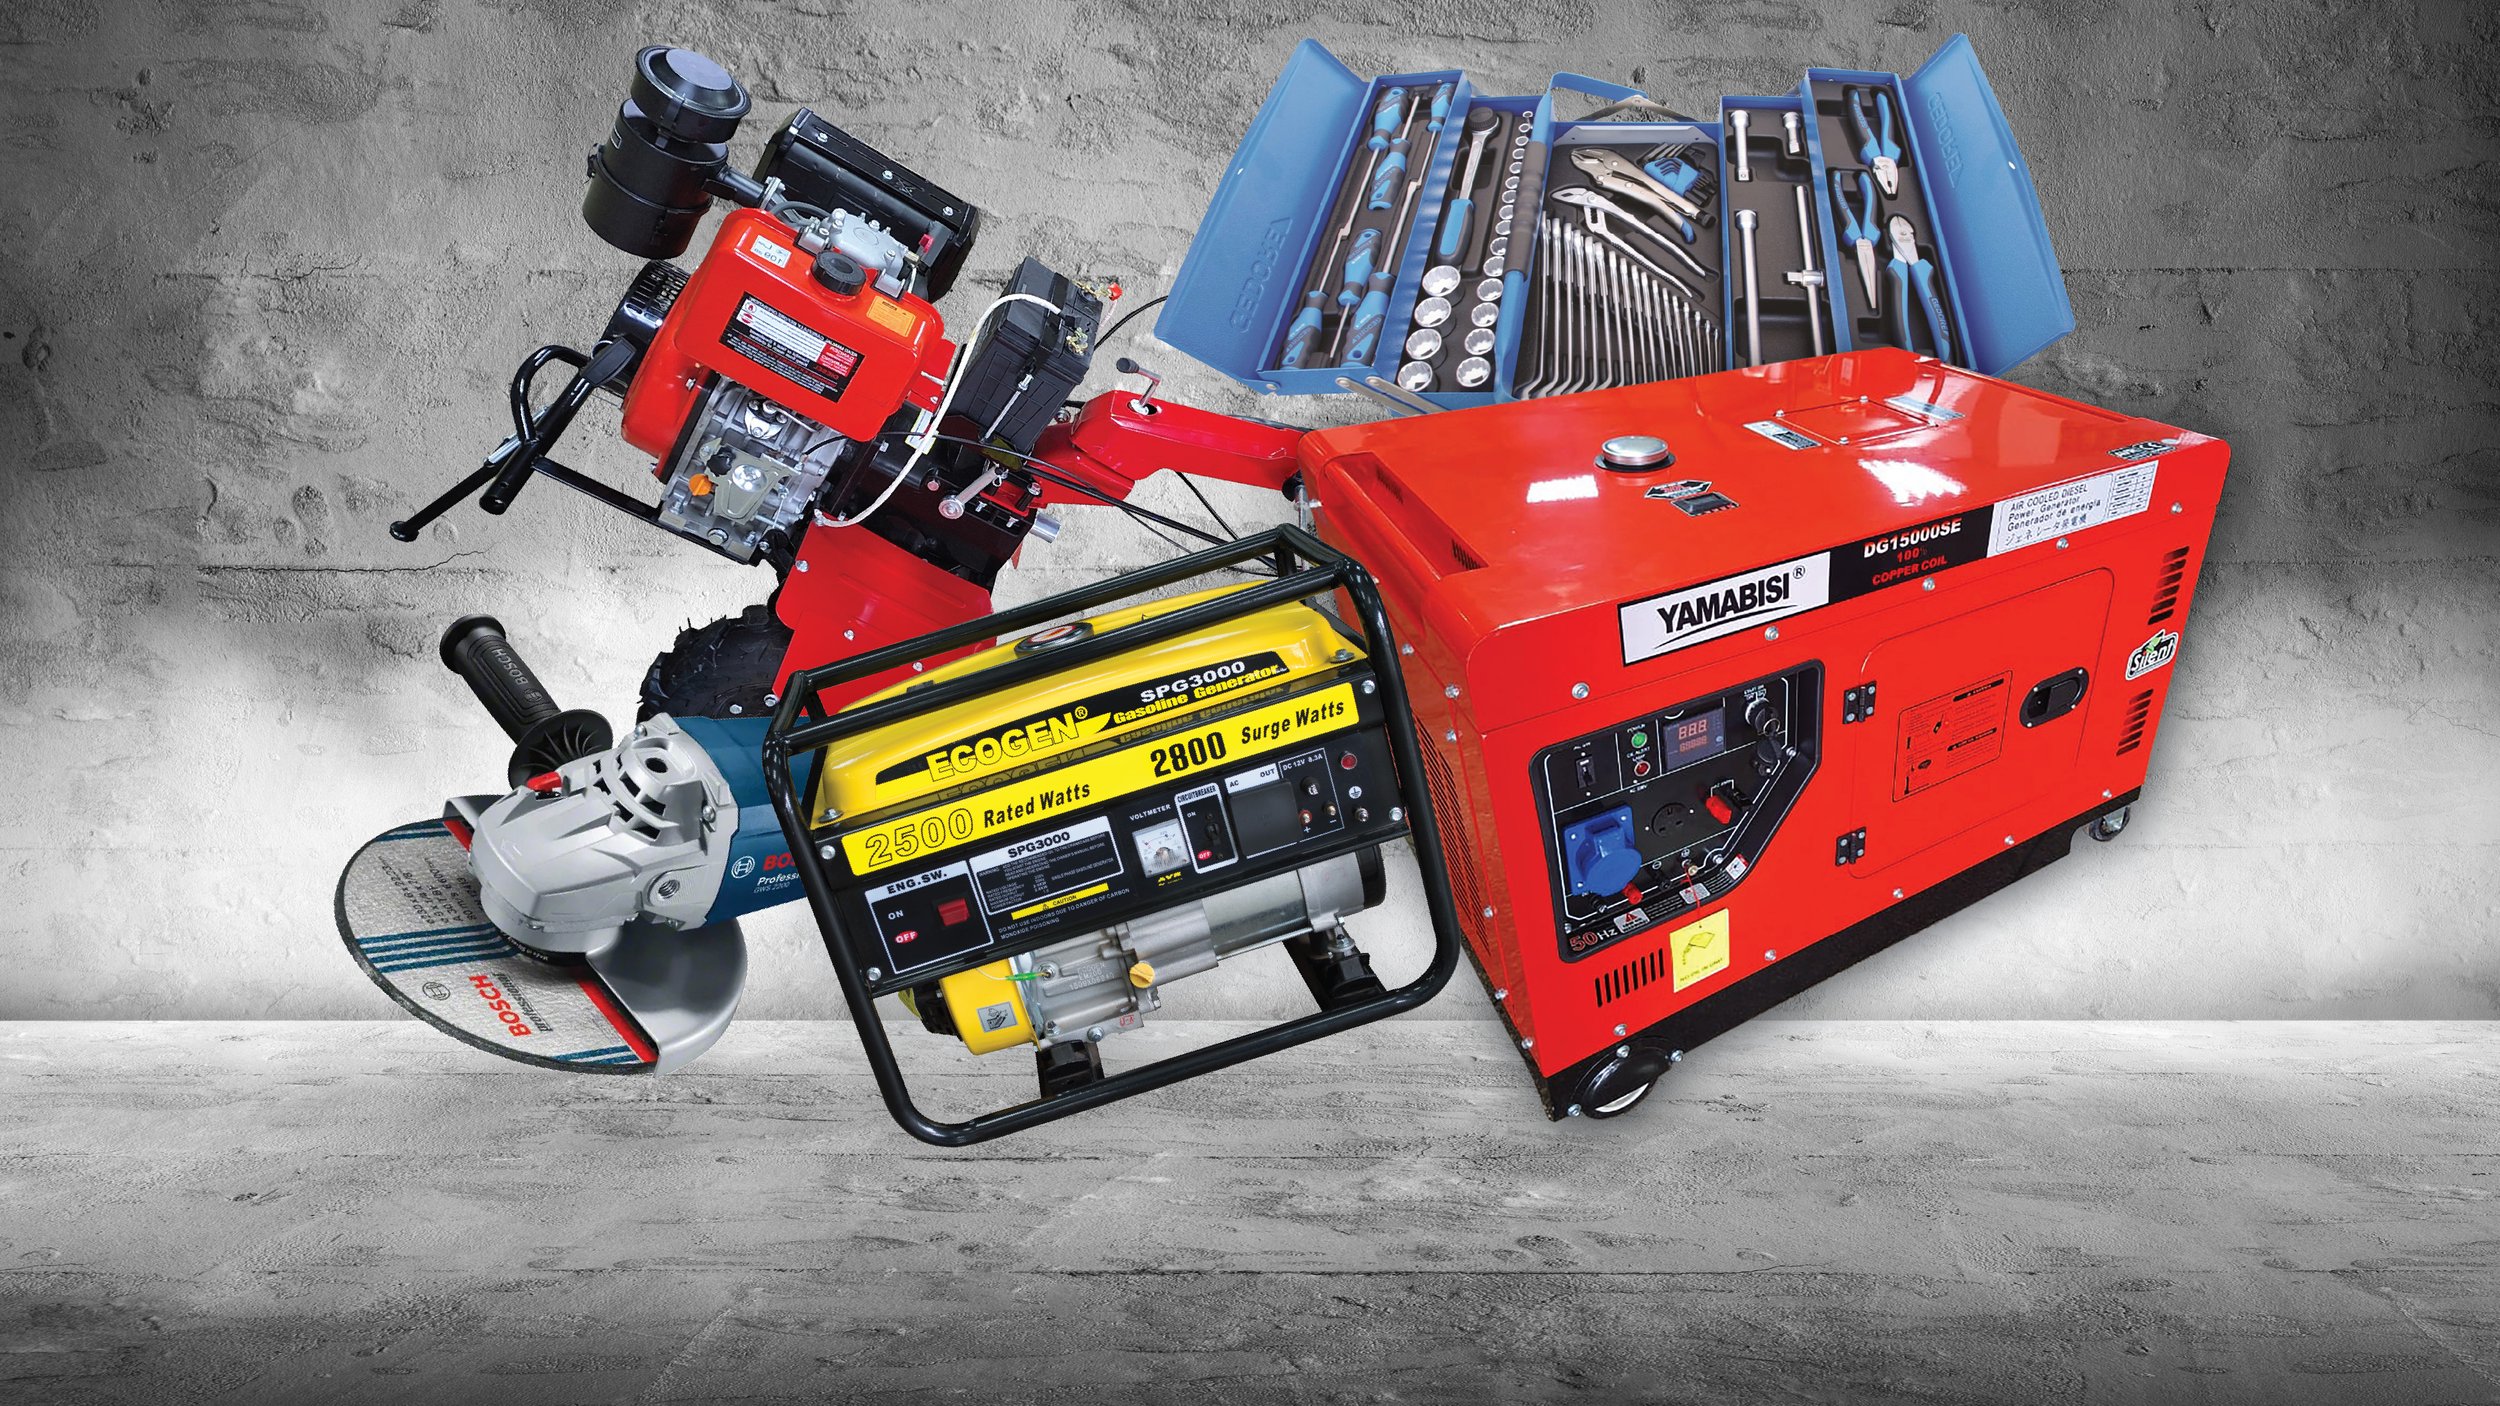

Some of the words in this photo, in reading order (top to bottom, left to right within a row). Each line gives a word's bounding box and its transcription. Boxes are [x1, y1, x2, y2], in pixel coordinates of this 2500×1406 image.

[2008, 508, 2035, 521] Power
[2040, 495, 2080, 513] Generator
[2010, 498, 2025, 512] AIR
[2026, 490, 2059, 507] COOLED
[2061, 483, 2088, 498] DIESEL
[2007, 513, 2054, 532] Generador
[2056, 507, 2067, 518] de
[1863, 518, 1962, 558] DG15000SE
[1872, 562, 1919, 586] COPPER
[1920, 555, 1948, 573] COIL
[491, 649, 528, 685] BOSCH
[2131, 639, 2174, 671] Silent
[1113, 692, 1188, 725] Gasoline
[1194, 663, 1280, 700] Generator
[1141, 661, 1246, 703] SPG3000
[1150, 731, 1227, 778] 2800
[1241, 716, 1291, 744] Surge
[1295, 699, 1345, 729] Watts
[1259, 767, 1275, 778] OUT
[1282, 762, 1293, 771] DC
[1293, 758, 1306, 769] 12V
[1307, 752, 1323, 763] 8.3A
[1177, 785, 1217, 803] CIRCUITBREAKER
[1229, 780, 1240, 788] AC
[1129, 804, 1171, 821] VOLTMETER
[865, 808, 974, 868] 2500
[983, 796, 1035, 829] Rated
[1038, 783, 1091, 811] Watts
[1008, 831, 1070, 858] SPG3000
[1199, 851, 1211, 859] OFF
[753, 884, 771, 893] GWS
[887, 870, 948, 895] ENG.SW.
[1030, 911, 1055, 922] INDOORS
[1055, 907, 1067, 915] DUE
[1075, 897, 1098, 908] DANGER
[1106, 887, 1130, 898] CARBON
[1052, 894, 1076, 905] CAUTION
[888, 909, 904, 920] ON
[895, 931, 917, 944] OFF
[1000, 927, 1028, 938] MONOXIDE
[1029, 917, 1059, 929] POISONING
[469, 975, 532, 1037] BOSCH
